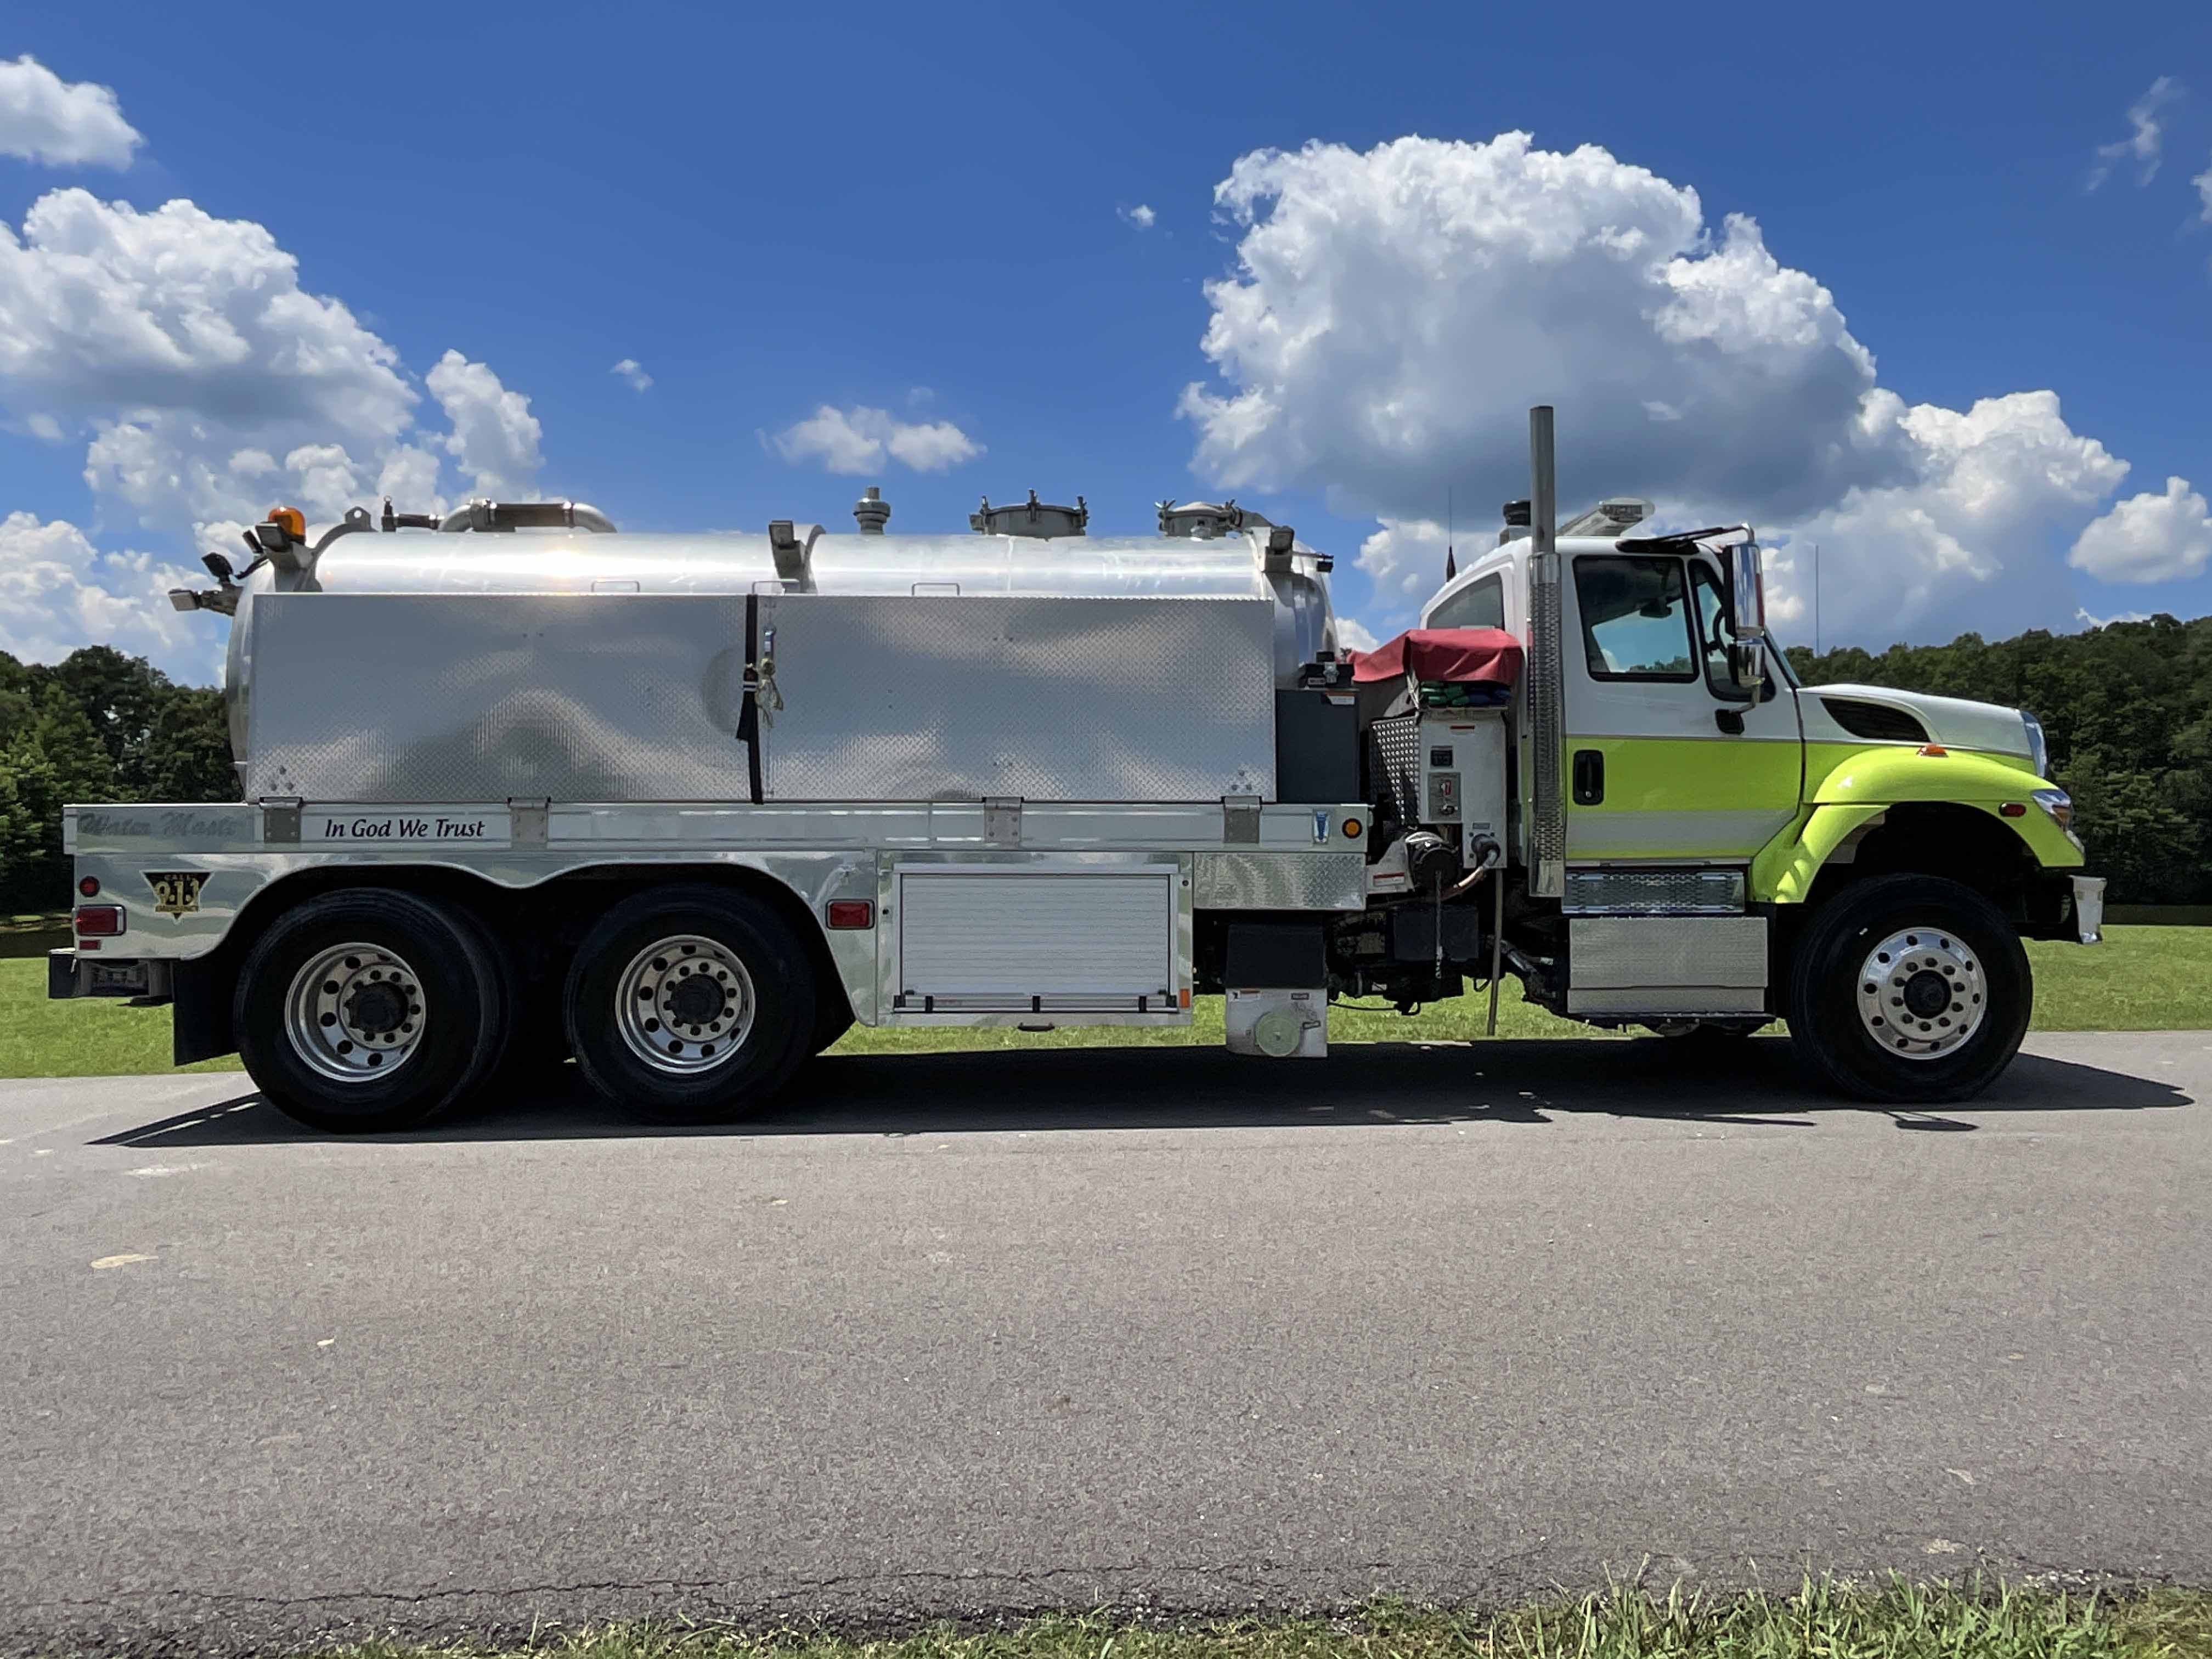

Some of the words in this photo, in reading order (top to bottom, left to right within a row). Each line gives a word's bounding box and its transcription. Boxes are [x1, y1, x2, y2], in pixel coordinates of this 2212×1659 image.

[325, 819, 345, 837] In
[351, 819, 392, 837] God
[399, 819, 429, 837] We
[436, 819, 486, 837] Trust
